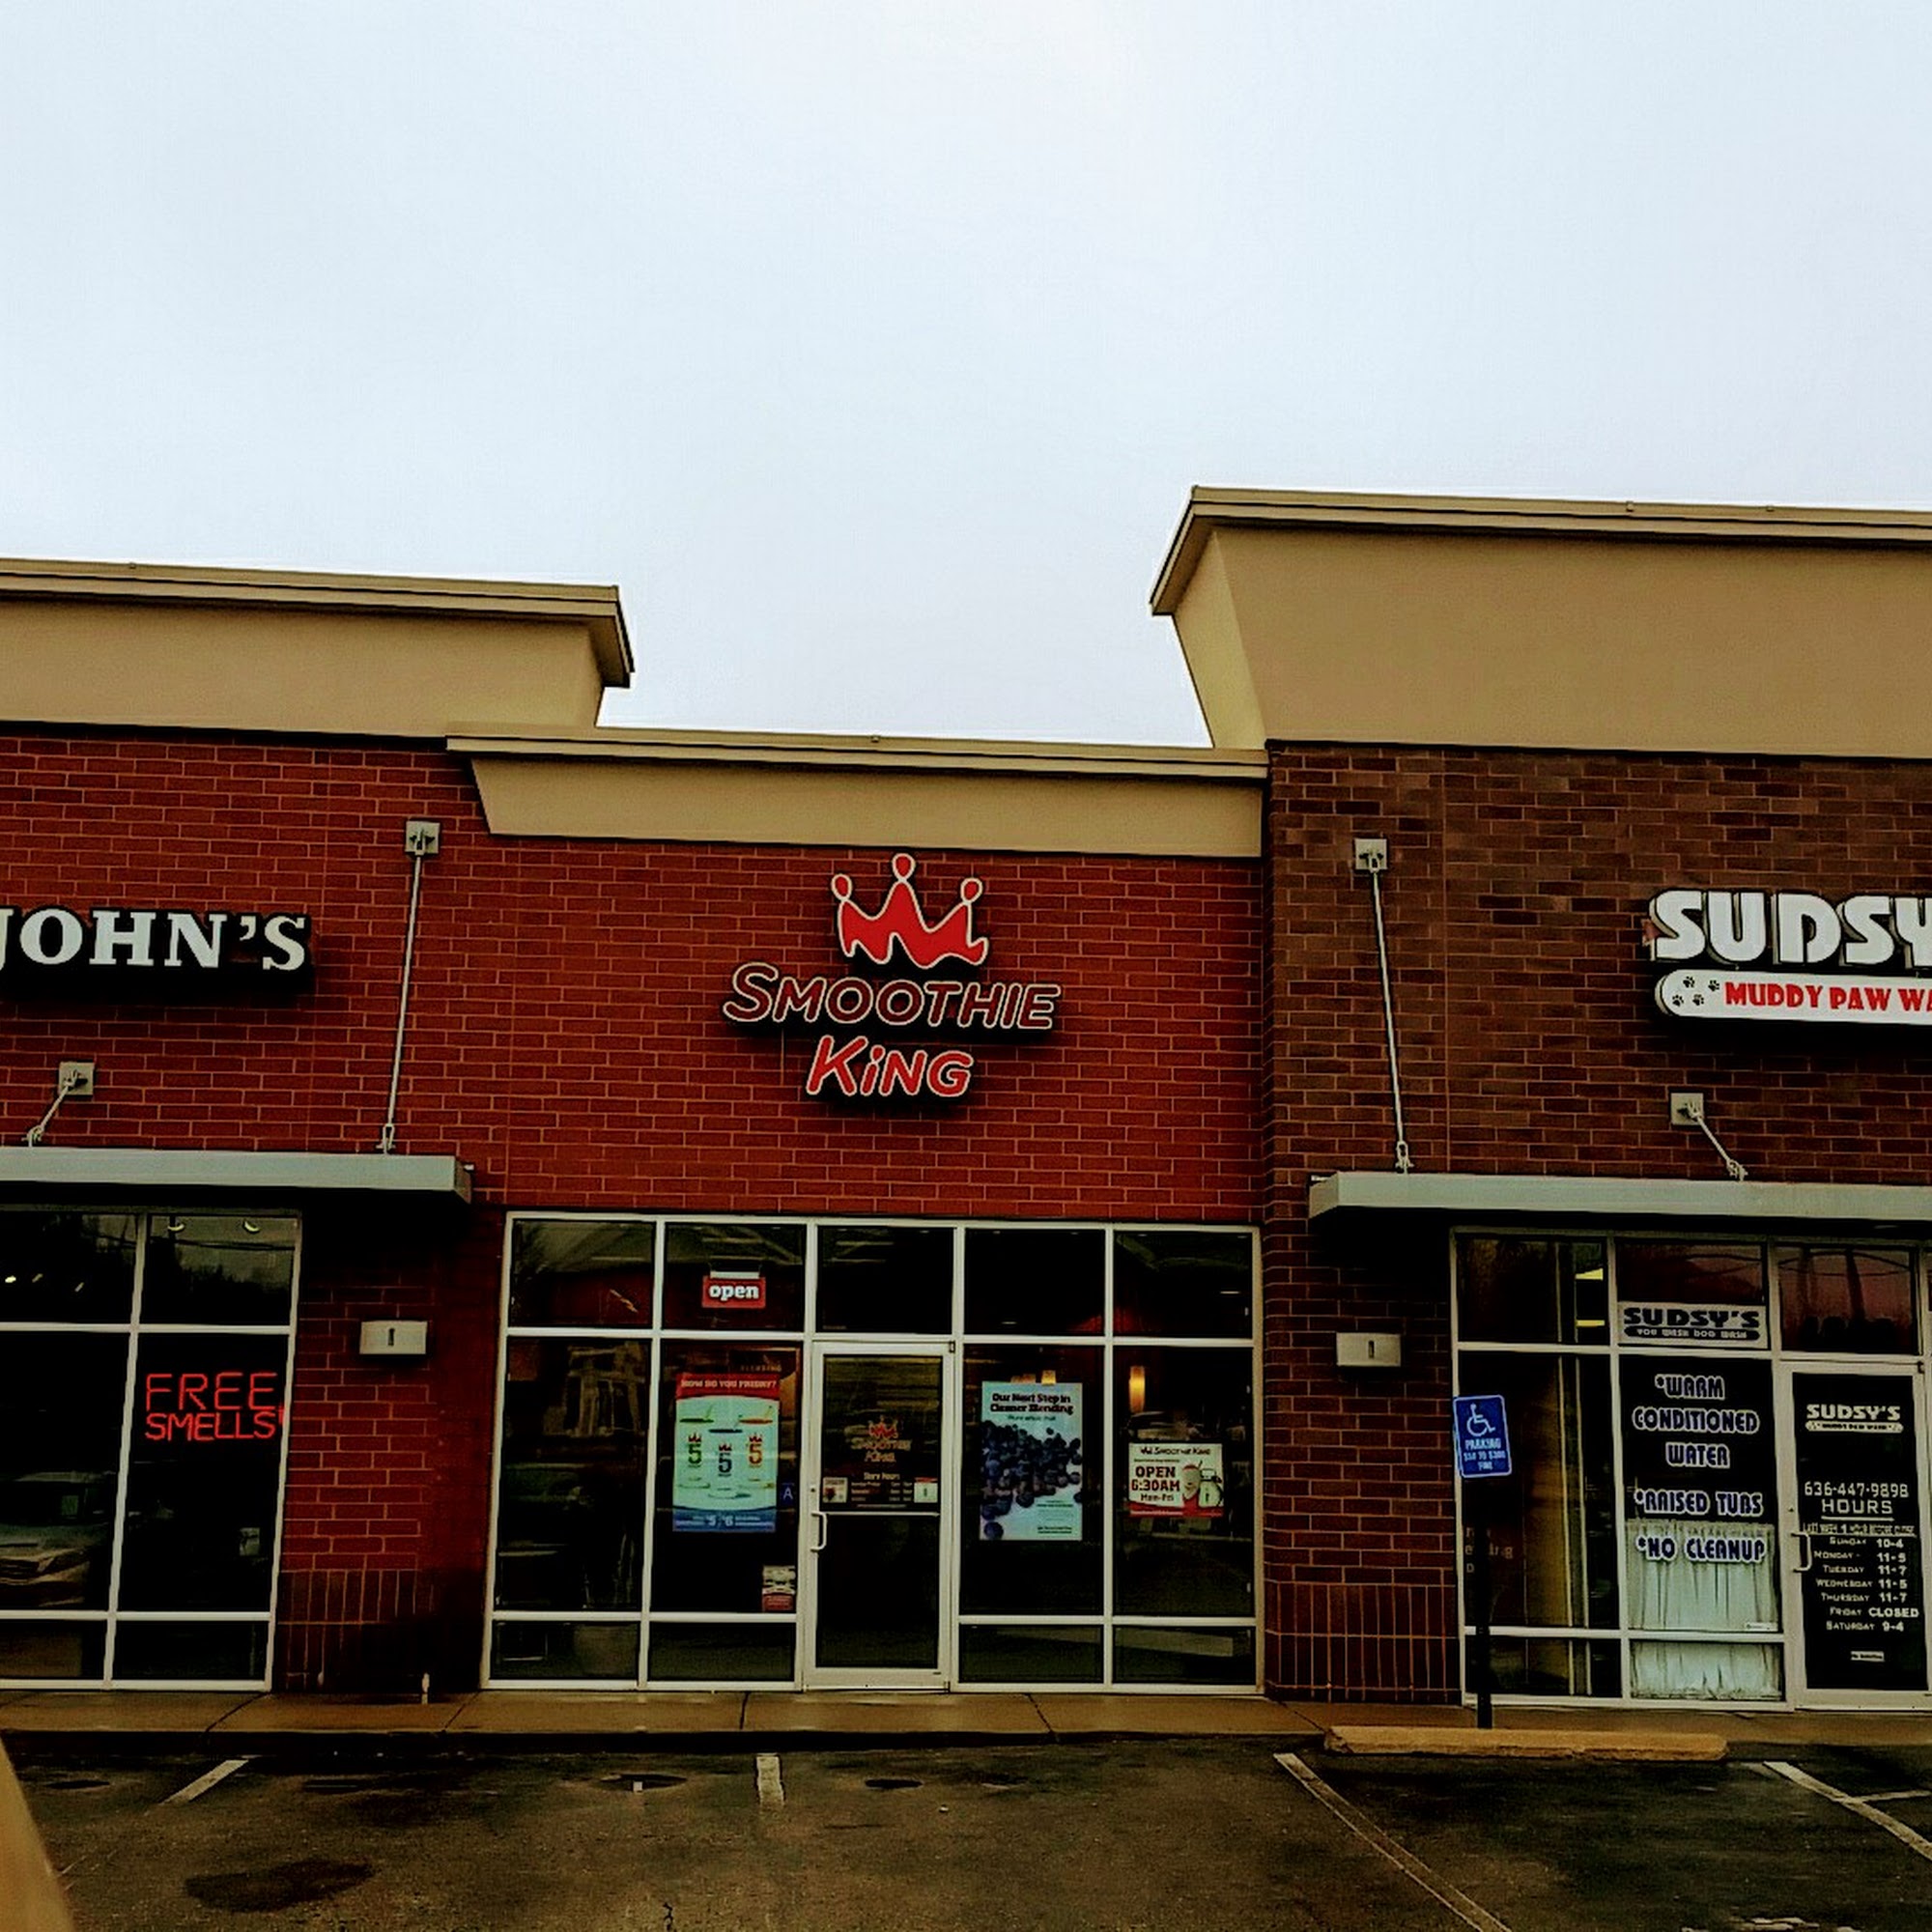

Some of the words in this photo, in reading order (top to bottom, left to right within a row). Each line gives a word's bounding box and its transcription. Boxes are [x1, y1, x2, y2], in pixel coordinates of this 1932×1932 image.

[724, 962, 1061, 1029] SMOOTHIE
[1725, 981, 1823, 1009] MUDDY
[1830, 986, 1891, 1011] PAW
[709, 1285, 759, 1301] open
[1624, 1307, 1760, 1328] SUDSY'S
[146, 1373, 277, 1411] FREE
[704, 1379, 718, 1388] DO
[720, 1379, 737, 1388] YOU
[1664, 1375, 1725, 1400] WARM
[992, 1393, 1010, 1402] Our
[1011, 1393, 1036, 1402] Next
[1037, 1393, 1060, 1405] Step
[1029, 1404, 1074, 1415] Blending
[1806, 1404, 1901, 1421] SUDSY'S
[145, 1411, 276, 1441] SMELLS
[1633, 1406, 1761, 1435] CONDITIONED
[688, 1443, 702, 1463] 5
[749, 1444, 762, 1463] 5
[1464, 1438, 1502, 1451] PARKING
[1665, 1442, 1730, 1468] WATER
[718, 1456, 732, 1473] 5
[1135, 1465, 1176, 1478] OPEN
[1131, 1479, 1180, 1492] 6:30AM
[1643, 1489, 1710, 1515] RAISED
[1715, 1492, 1764, 1517] TUBS
[1821, 1499, 1893, 1514] HOURS
[1646, 1536, 1677, 1560] NO
[1685, 1537, 1767, 1564] CLEANUP
[1877, 1538, 1904, 1548] 10-4
[1868, 1607, 1919, 1617] CLOSED
